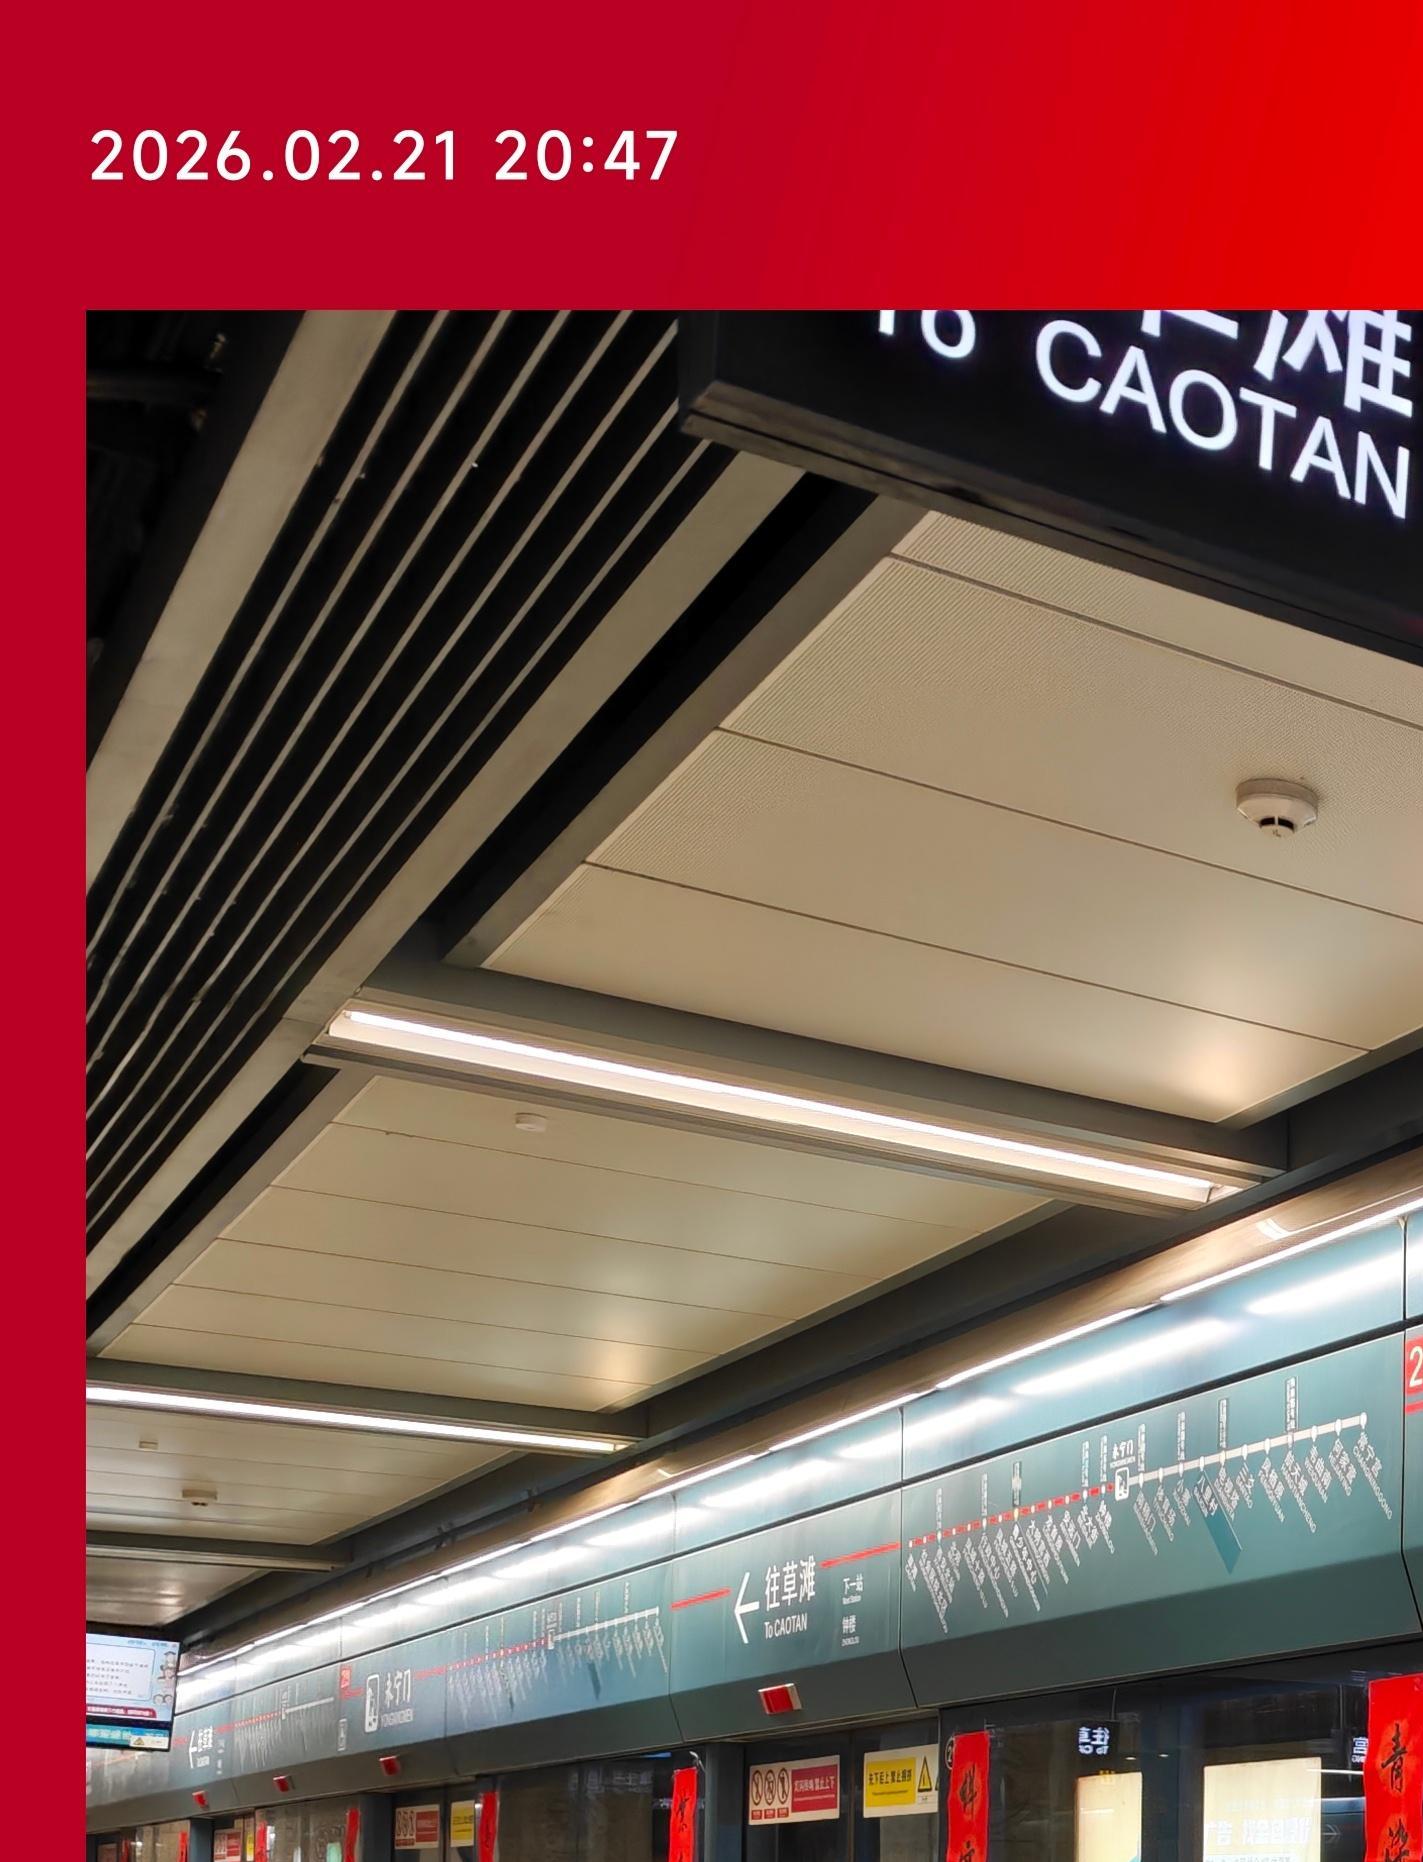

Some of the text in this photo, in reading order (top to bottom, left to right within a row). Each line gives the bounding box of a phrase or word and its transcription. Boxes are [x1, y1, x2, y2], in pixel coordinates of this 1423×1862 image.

[1035, 319, 1411, 520] CAOTAN
[765, 1555, 816, 1612] 往草滩
[764, 1612, 808, 1640] To CAOTAN
